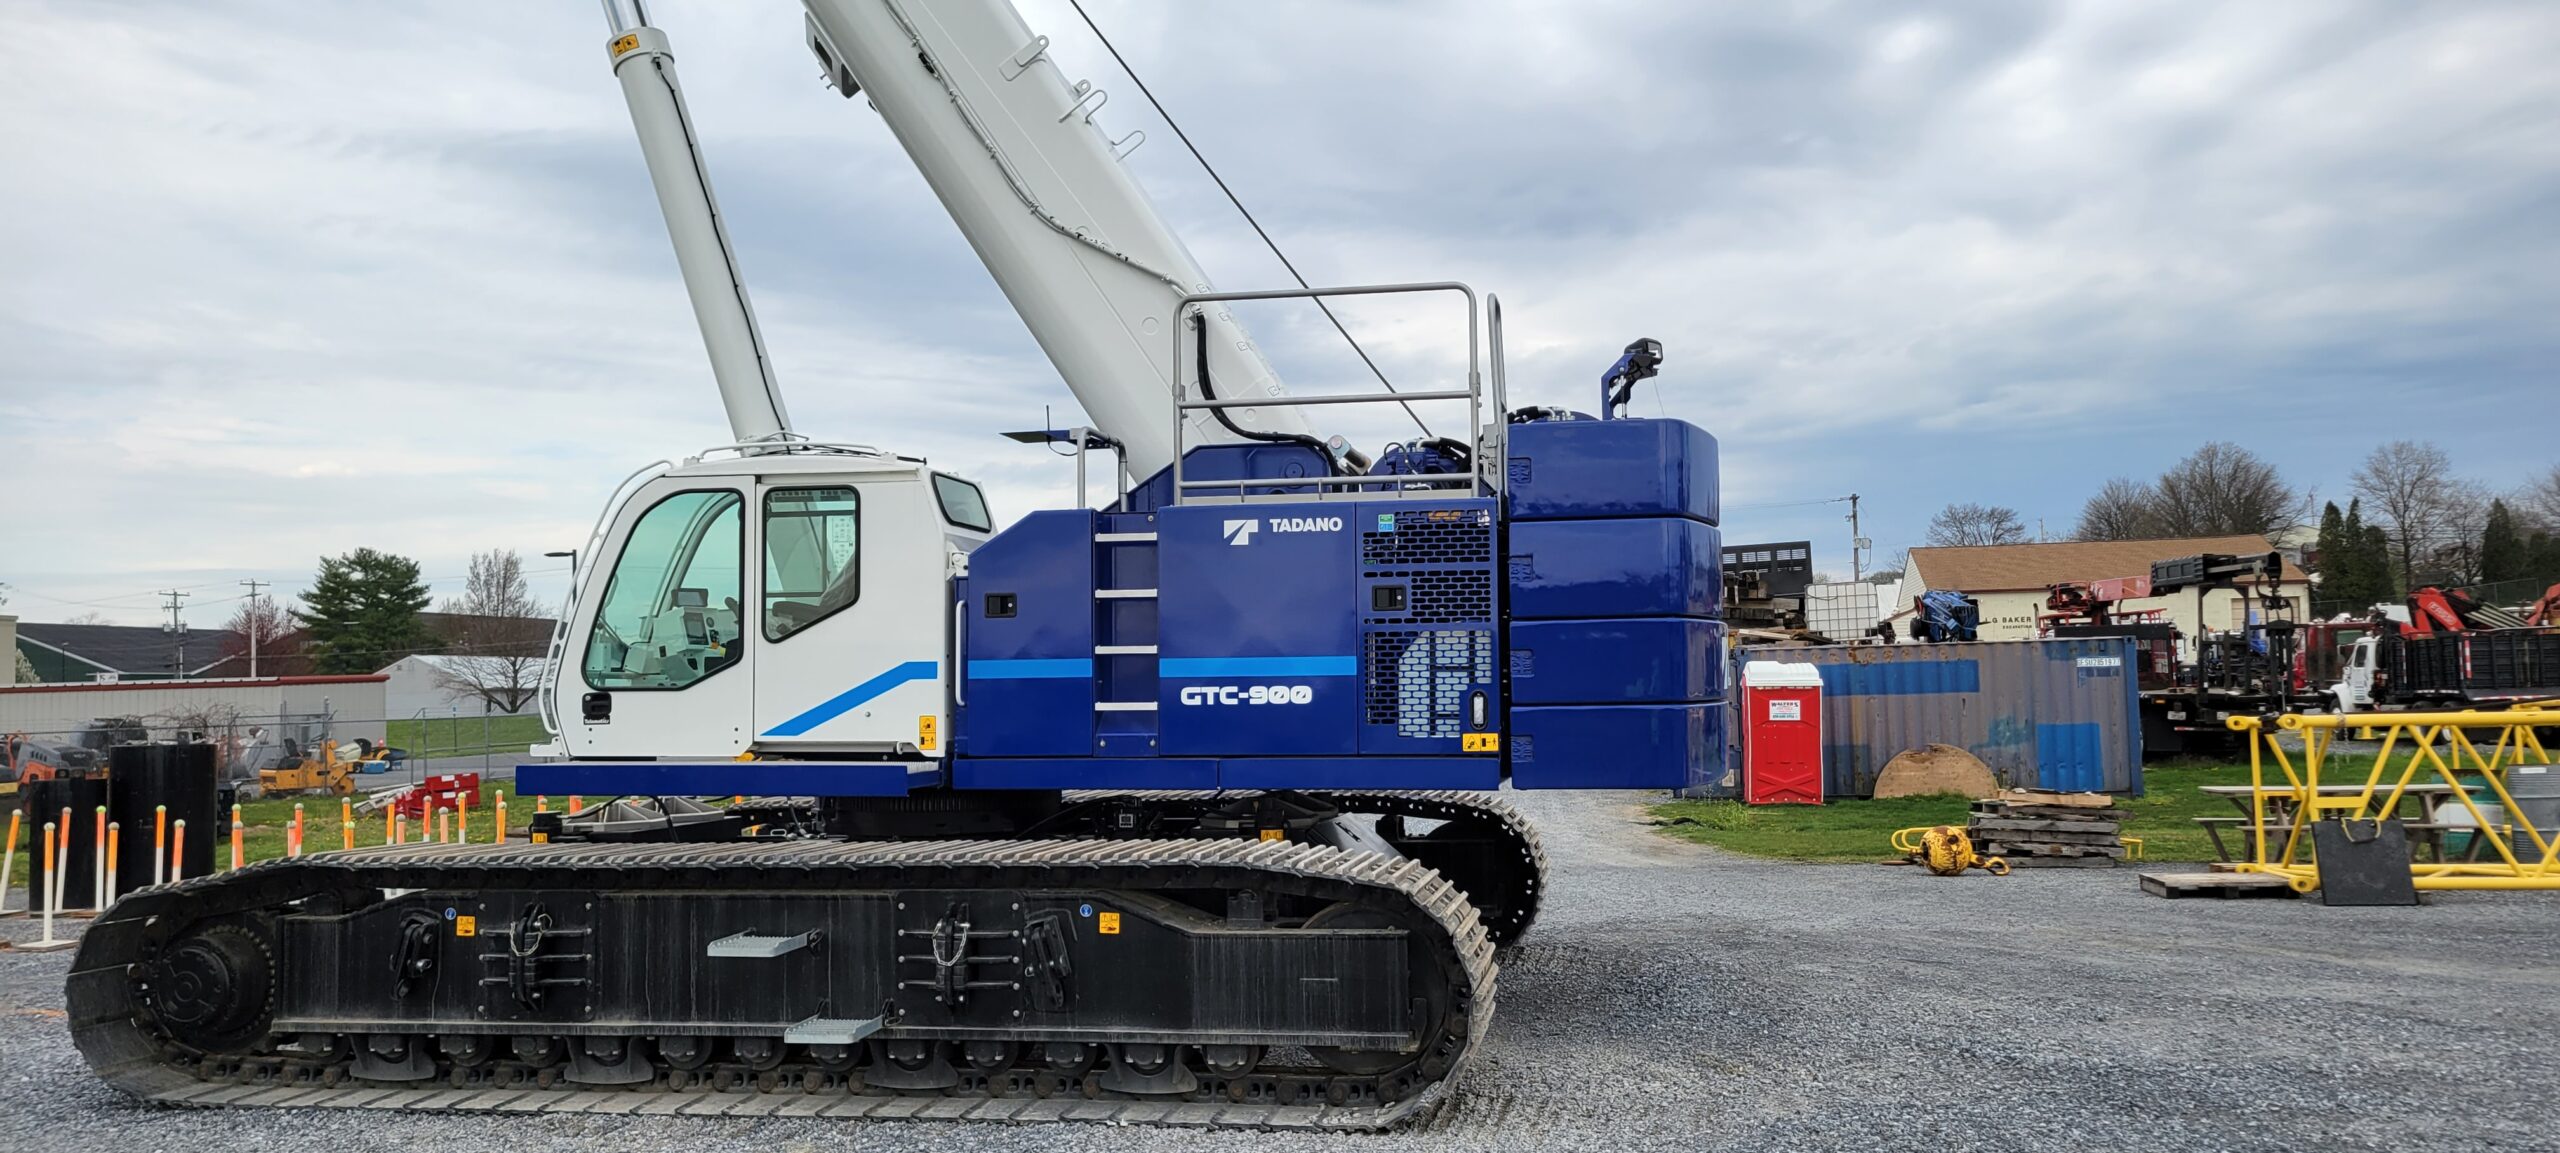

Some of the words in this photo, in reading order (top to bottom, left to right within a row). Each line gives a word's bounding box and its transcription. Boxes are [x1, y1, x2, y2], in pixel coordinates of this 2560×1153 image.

[1269, 517, 1343, 533] TADANO
[2002, 616, 2032, 624] BAKER
[1180, 686, 1313, 705] GTC-900
